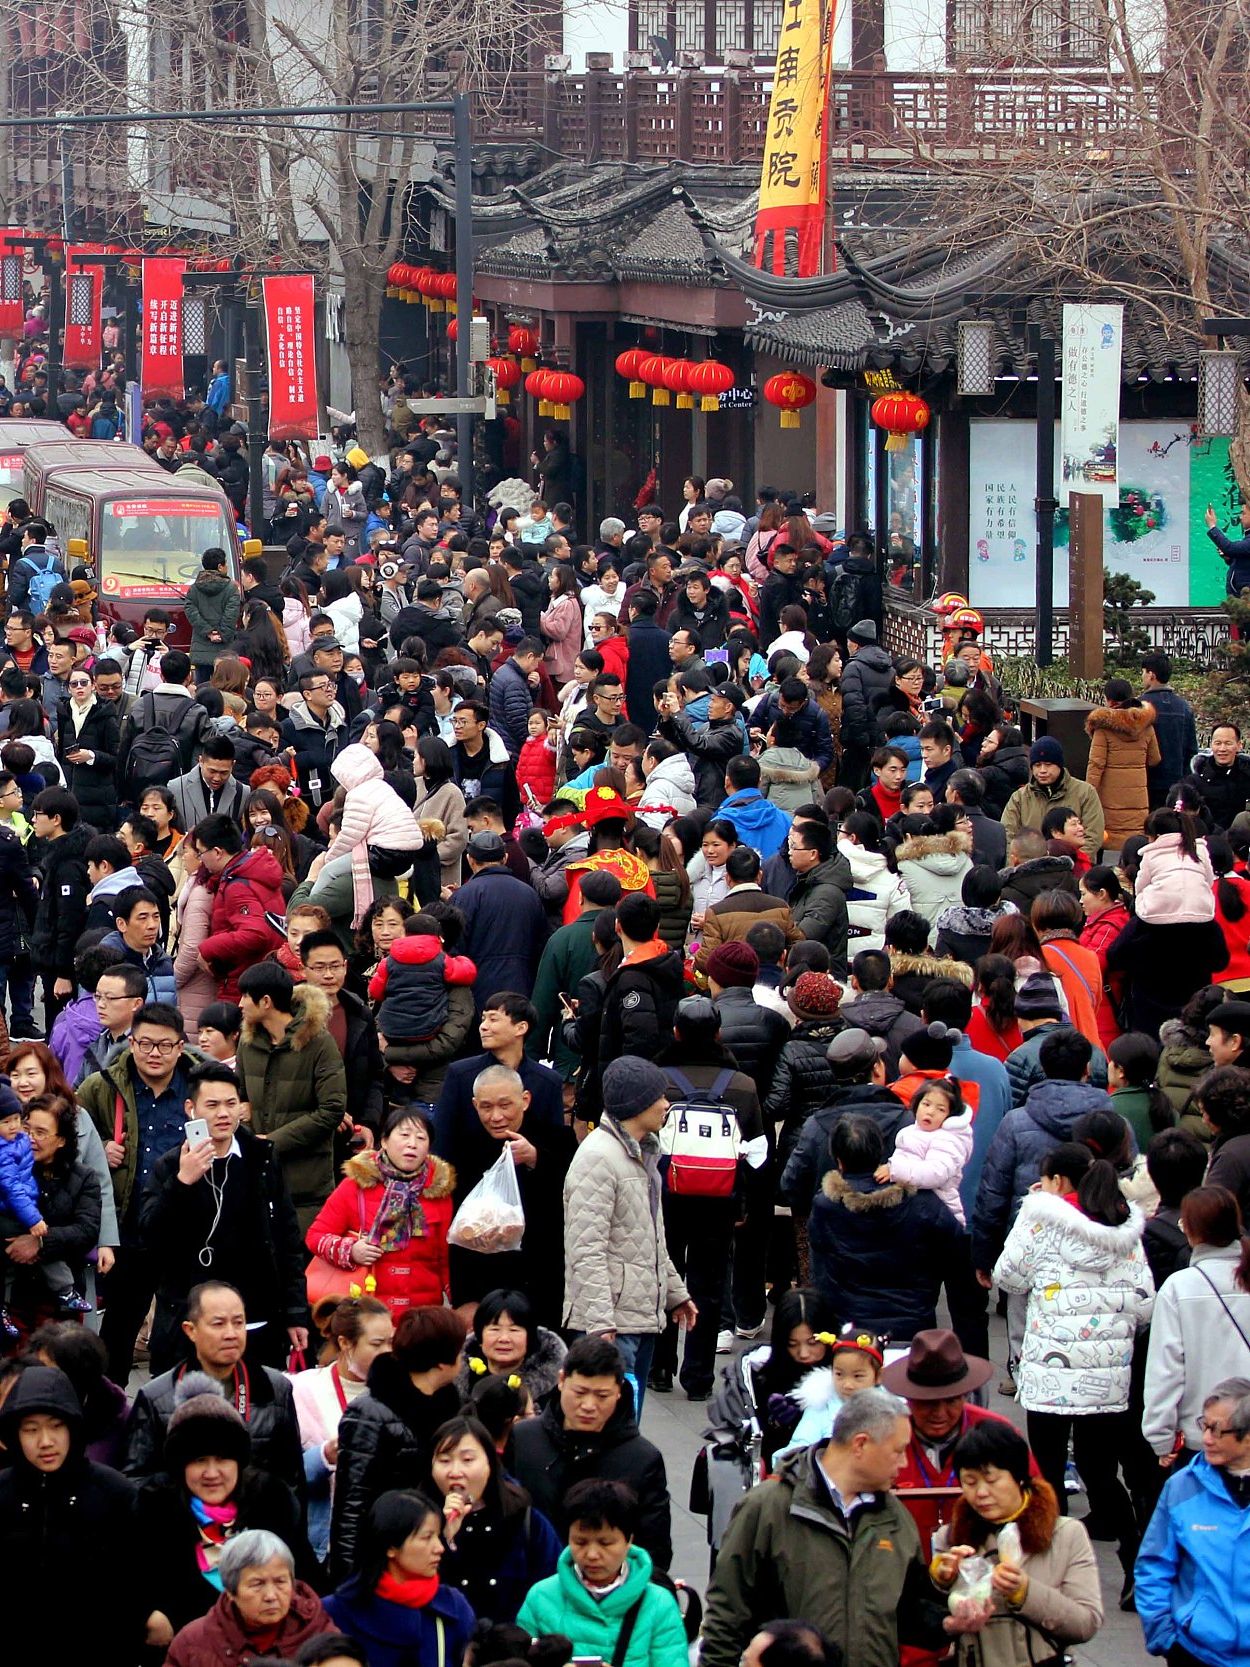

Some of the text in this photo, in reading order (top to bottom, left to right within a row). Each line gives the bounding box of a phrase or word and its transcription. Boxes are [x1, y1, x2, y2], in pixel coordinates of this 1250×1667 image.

[149, 299, 158, 355] 续写新篇章
[159, 299, 168, 355] 开启新征程
[169, 299, 178, 355] 迈进新时代
[277, 307, 286, 368] 自信、文化自信
[285, 306, 296, 403] 路自信、理论自信、制度
[294, 306, 304, 403] 坚定中国特色社会主义道
[1066, 347, 1078, 412] 做有德之人
[985, 483, 994, 539] 国家有力量
[997, 483, 1005, 539] 民族有希望
[1008, 483, 1017, 539] 人民有信仰
[106, 578, 116, 591] 9
